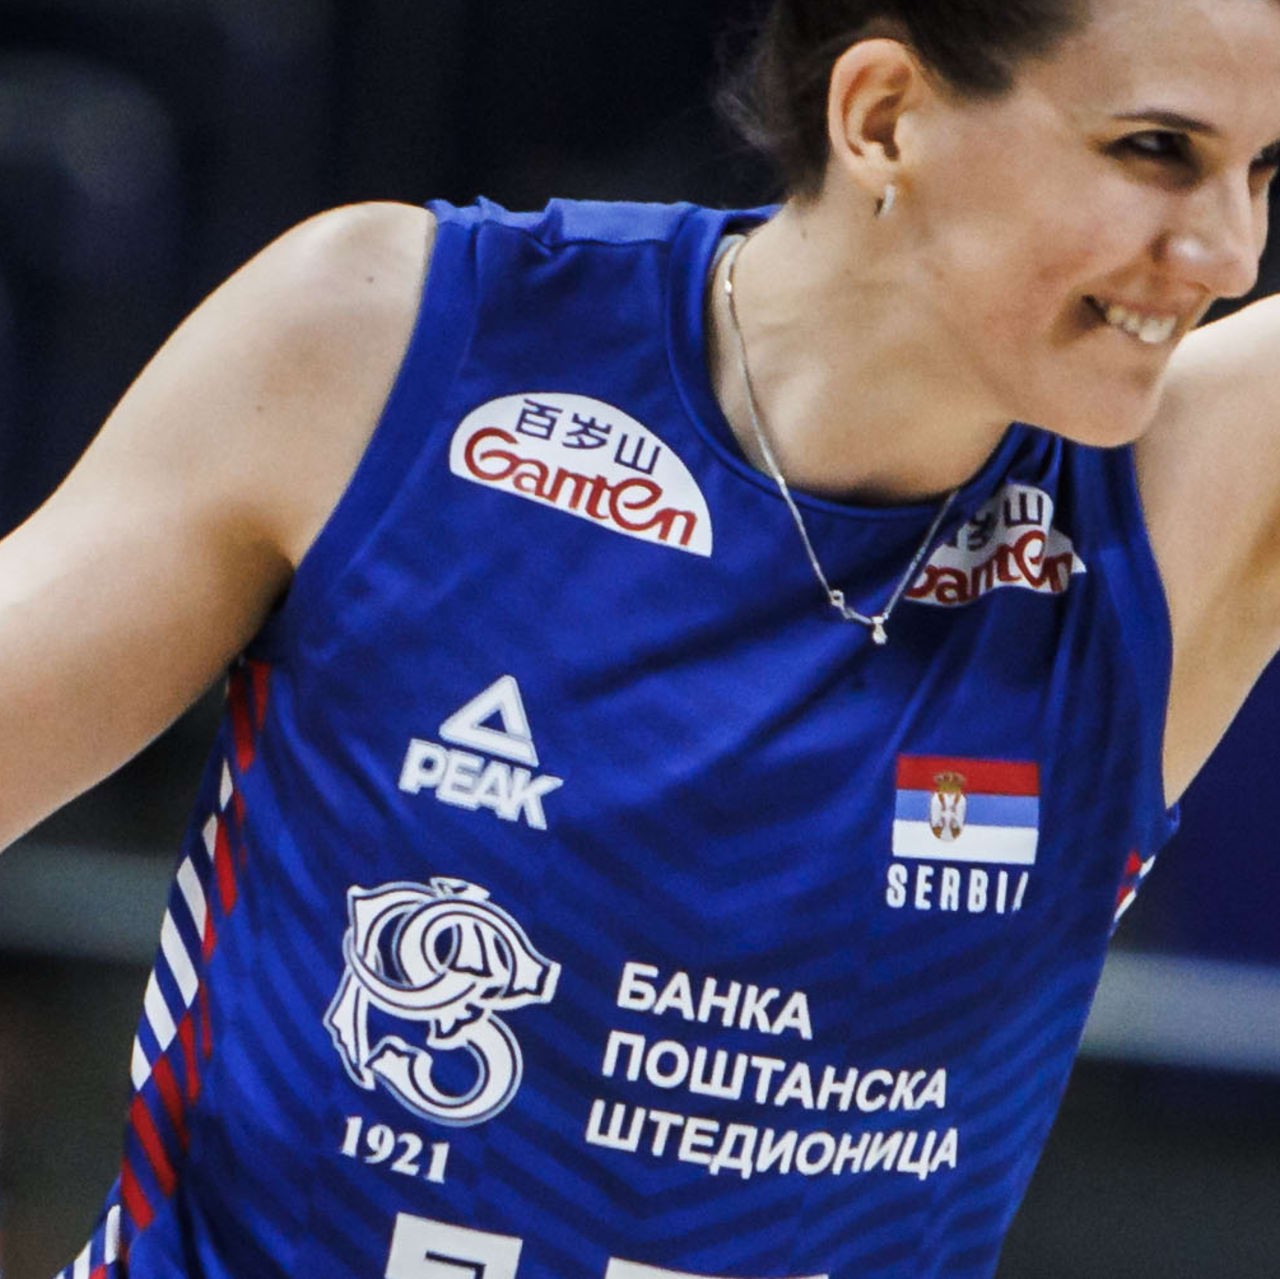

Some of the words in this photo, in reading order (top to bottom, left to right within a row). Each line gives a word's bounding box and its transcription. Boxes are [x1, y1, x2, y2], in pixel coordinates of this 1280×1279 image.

[515, 398, 661, 475] 百岁山
[398, 738, 564, 830] PEAK
[617, 961, 813, 1040] БАНКА
[602, 1030, 946, 1112] ПОШТАНСКА
[341, 1116, 450, 1184] 1921
[585, 1099, 958, 1181] ШТЕДИОНИЦА
